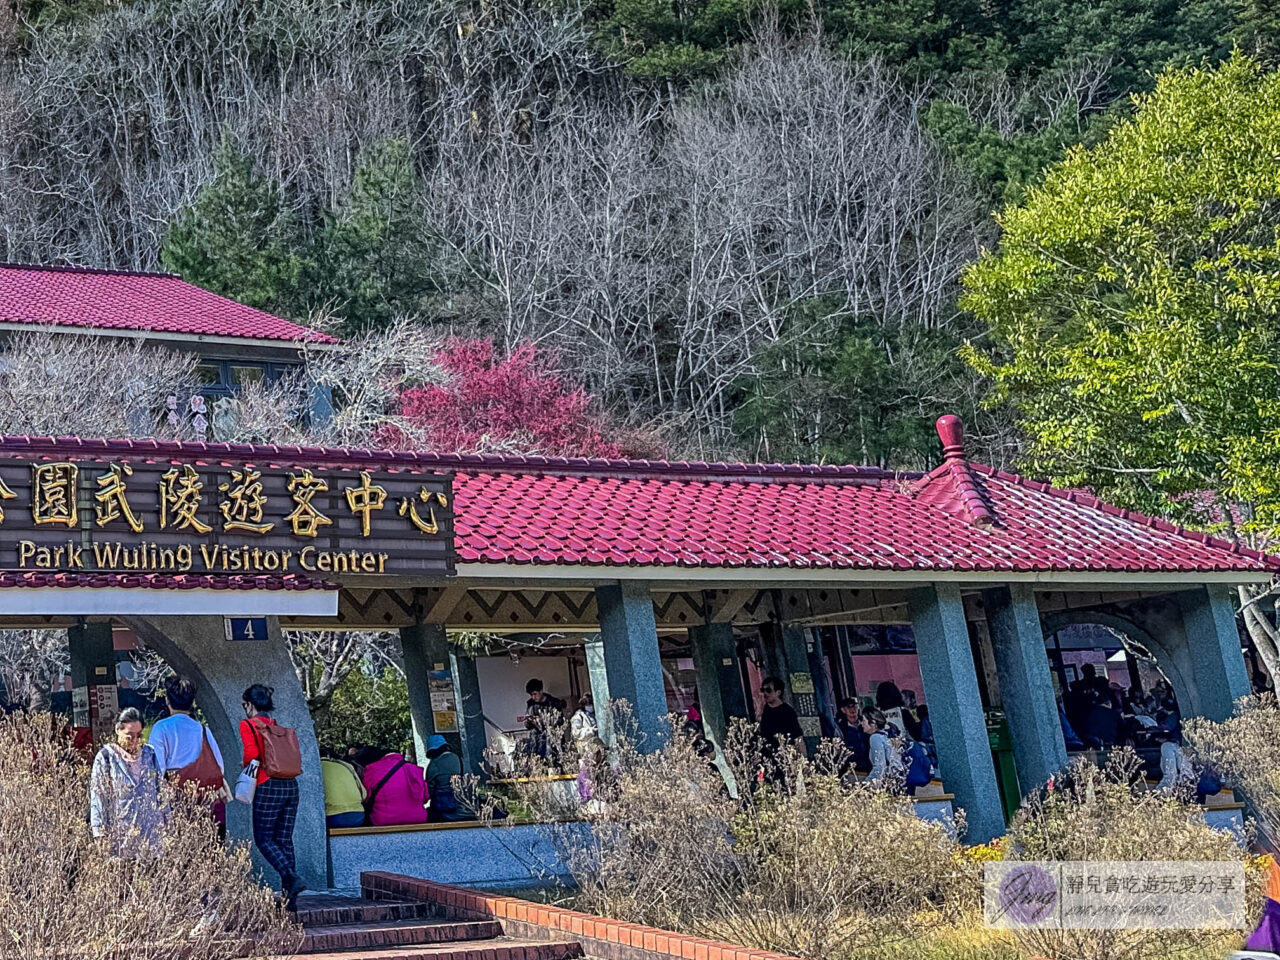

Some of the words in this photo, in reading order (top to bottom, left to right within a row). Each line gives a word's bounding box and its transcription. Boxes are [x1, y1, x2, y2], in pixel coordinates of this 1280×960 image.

[20, 540, 84, 569] Park
[93, 542, 193, 572] Wuling
[200, 544, 293, 572] Visitor
[299, 545, 389, 573] Center
[244, 619, 255, 639] 4
